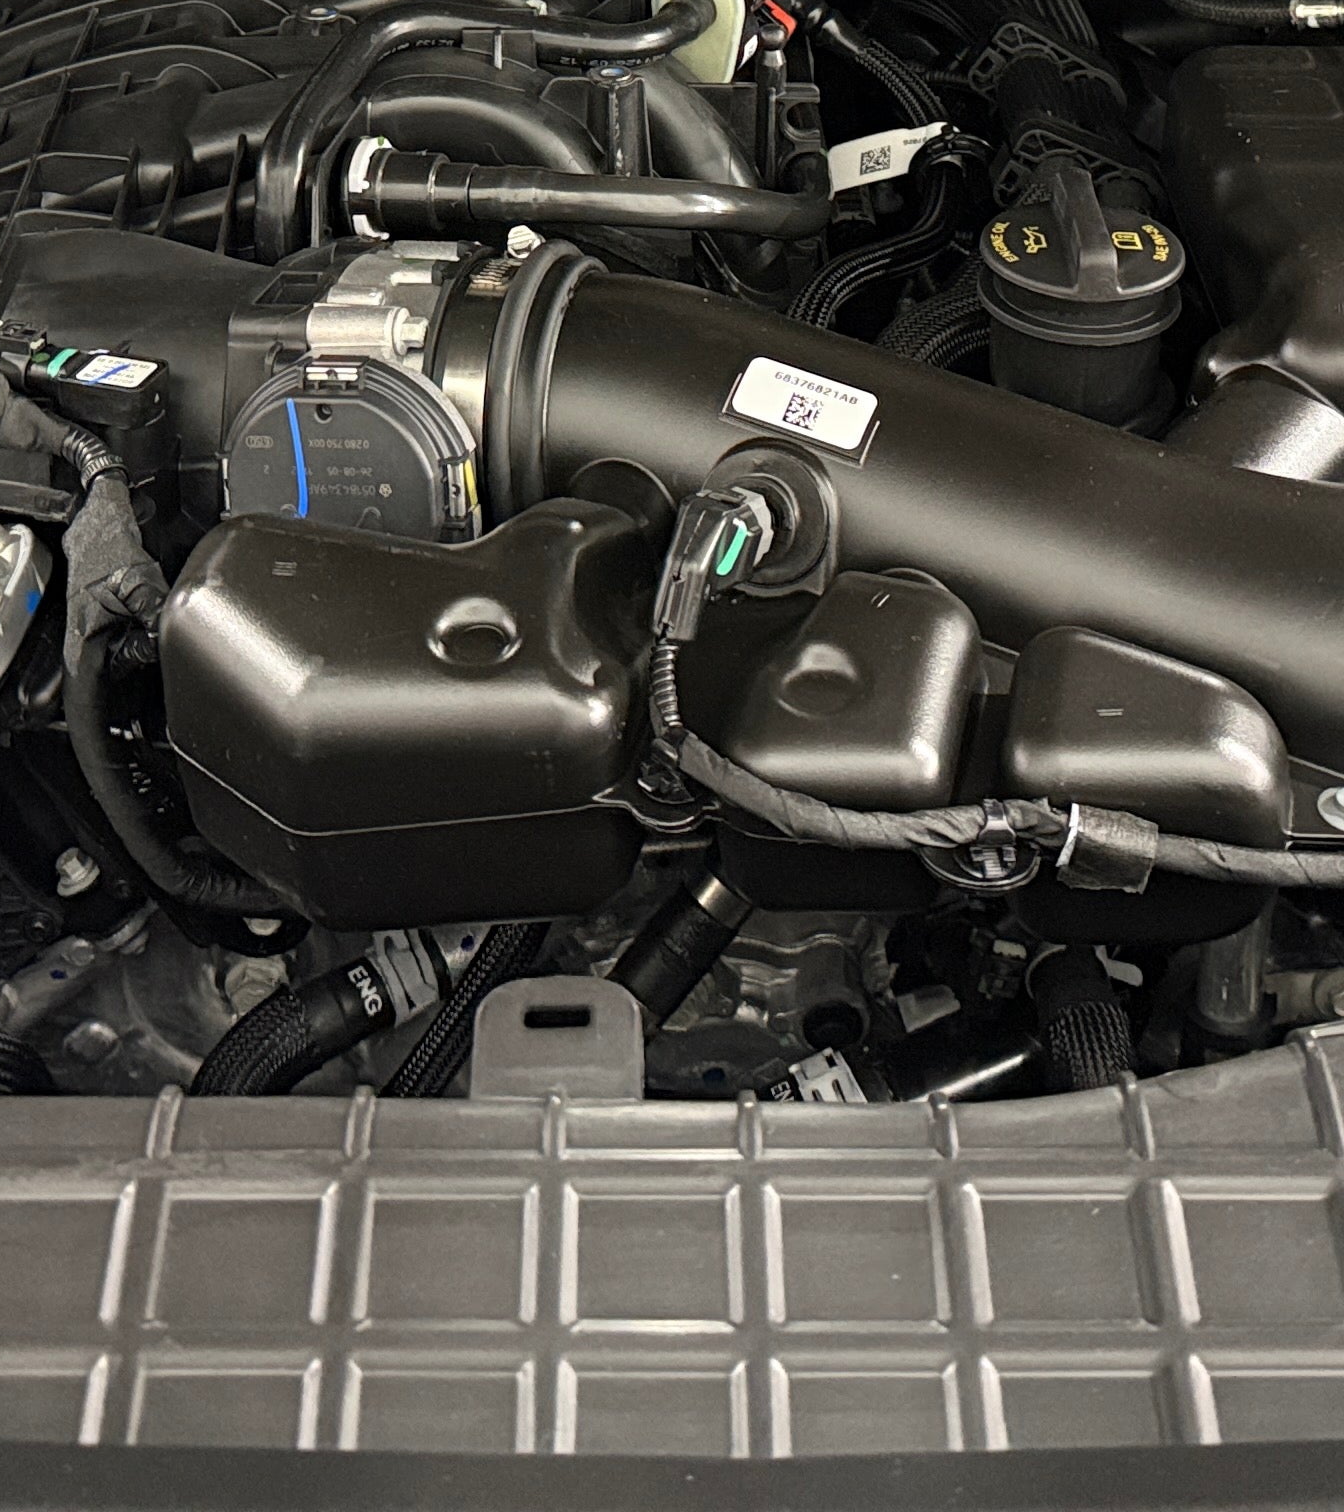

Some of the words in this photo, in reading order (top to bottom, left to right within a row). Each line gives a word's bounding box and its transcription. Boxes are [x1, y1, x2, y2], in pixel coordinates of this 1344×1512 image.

[990, 233, 1021, 263] ENGINE
[773, 370, 859, 406] 68376821AB
[347, 965, 383, 1017] ENG
